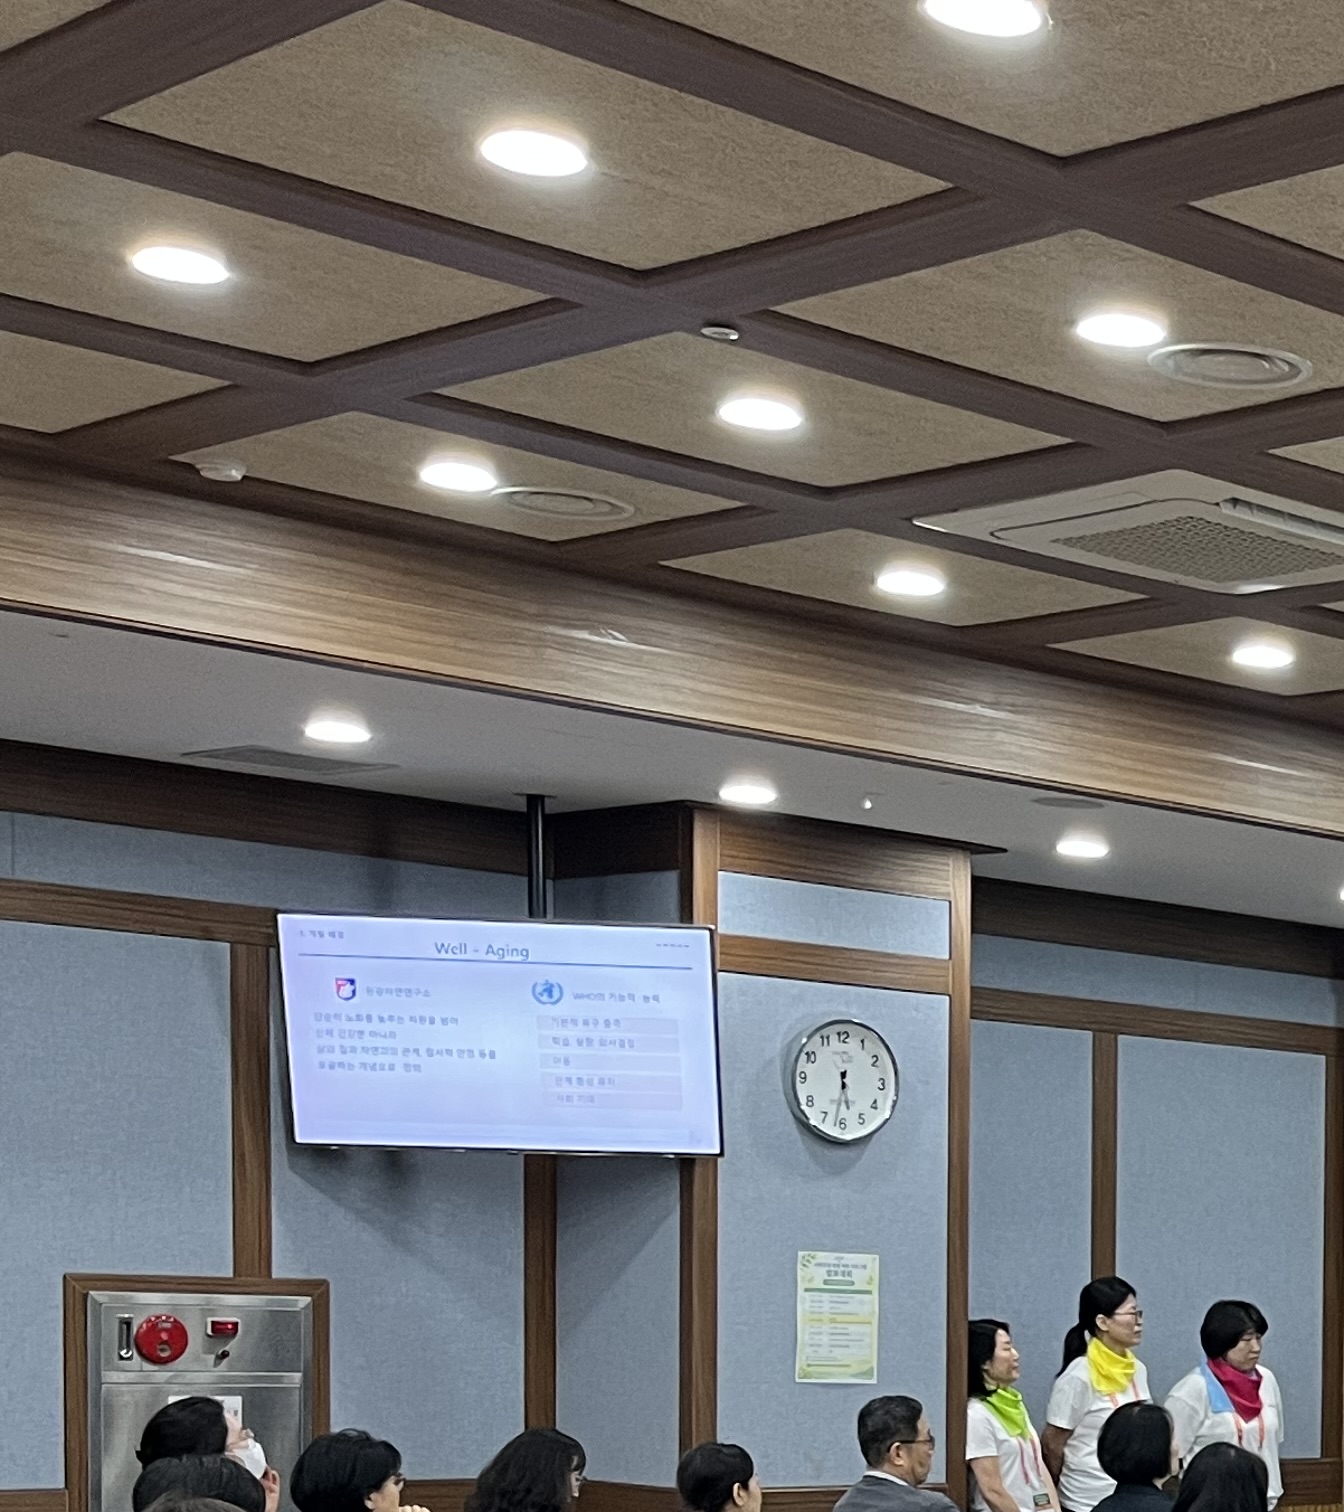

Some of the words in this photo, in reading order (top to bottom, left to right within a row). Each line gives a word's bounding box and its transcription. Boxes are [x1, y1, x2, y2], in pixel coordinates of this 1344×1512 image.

[485, 943, 530, 960] Aging
[820, 1034, 831, 1047] 11
[836, 1030, 850, 1044] 12
[860, 1038, 865, 1051] 1
[804, 1050, 817, 1064] 10
[871, 1054, 879, 1068] 2
[798, 1070, 807, 1084] 9
[877, 1077, 886, 1091] 3
[805, 1094, 814, 1108] 8
[870, 1098, 878, 1111] 4
[820, 1110, 828, 1124] 7
[838, 1117, 847, 1131] 6
[858, 1112, 866, 1126] 5
